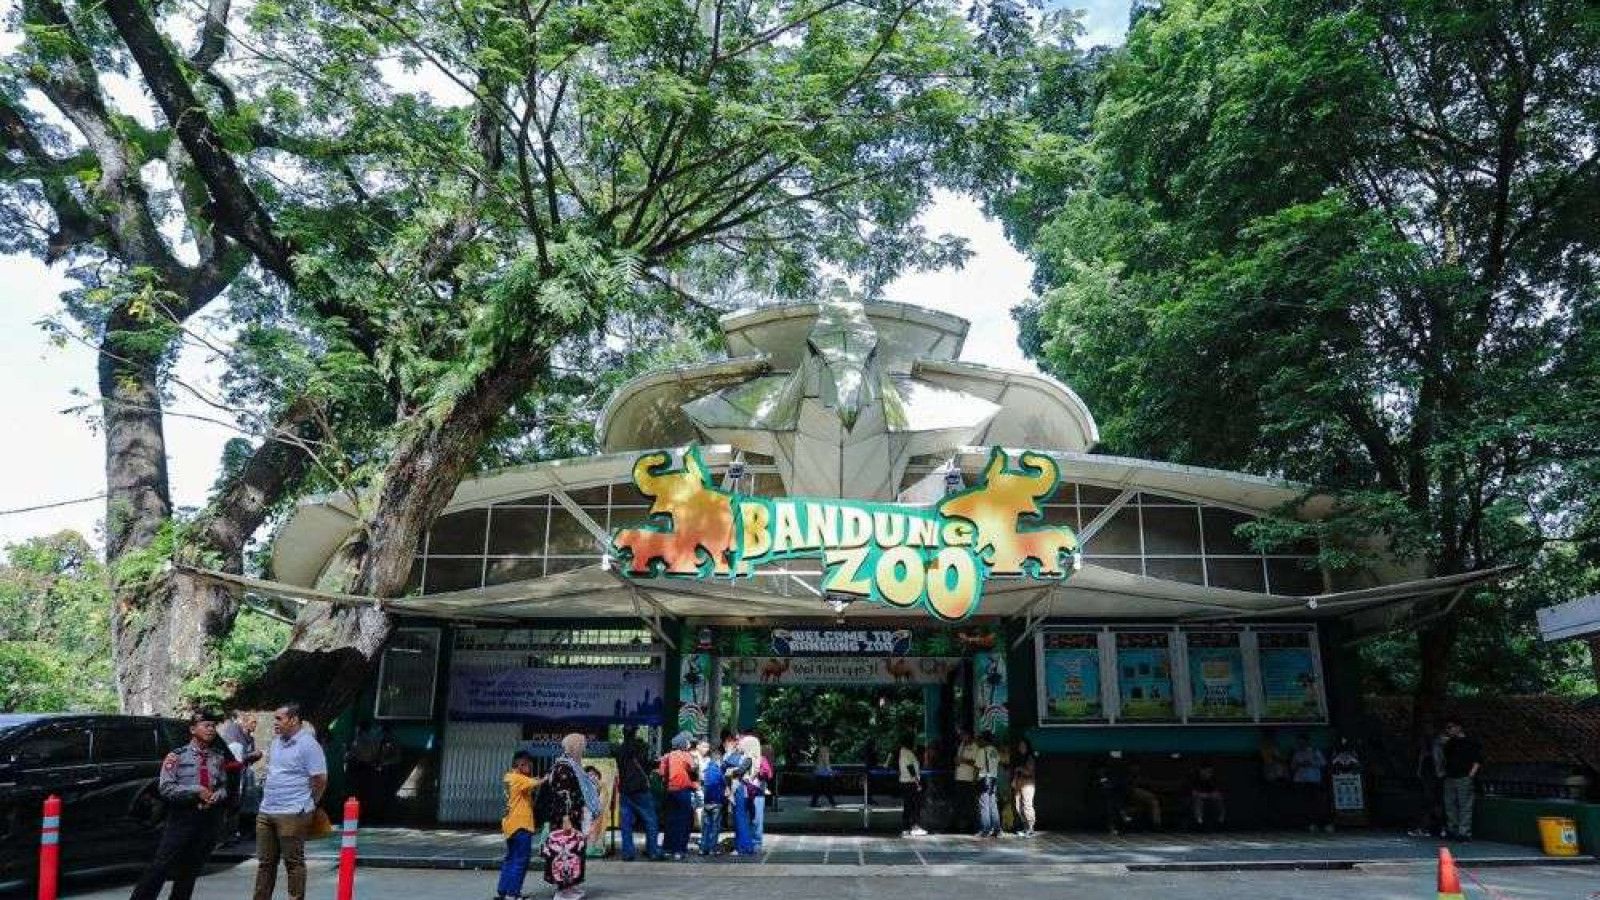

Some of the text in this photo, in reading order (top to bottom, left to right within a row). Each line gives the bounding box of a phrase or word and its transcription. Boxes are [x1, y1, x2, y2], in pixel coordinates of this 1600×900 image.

[740, 501, 974, 558] BANDUNG
[824, 547, 976, 618] ZOO
[789, 641, 893, 651] BANDUNG ZOO
[790, 631, 892, 642] WELCOME TO
